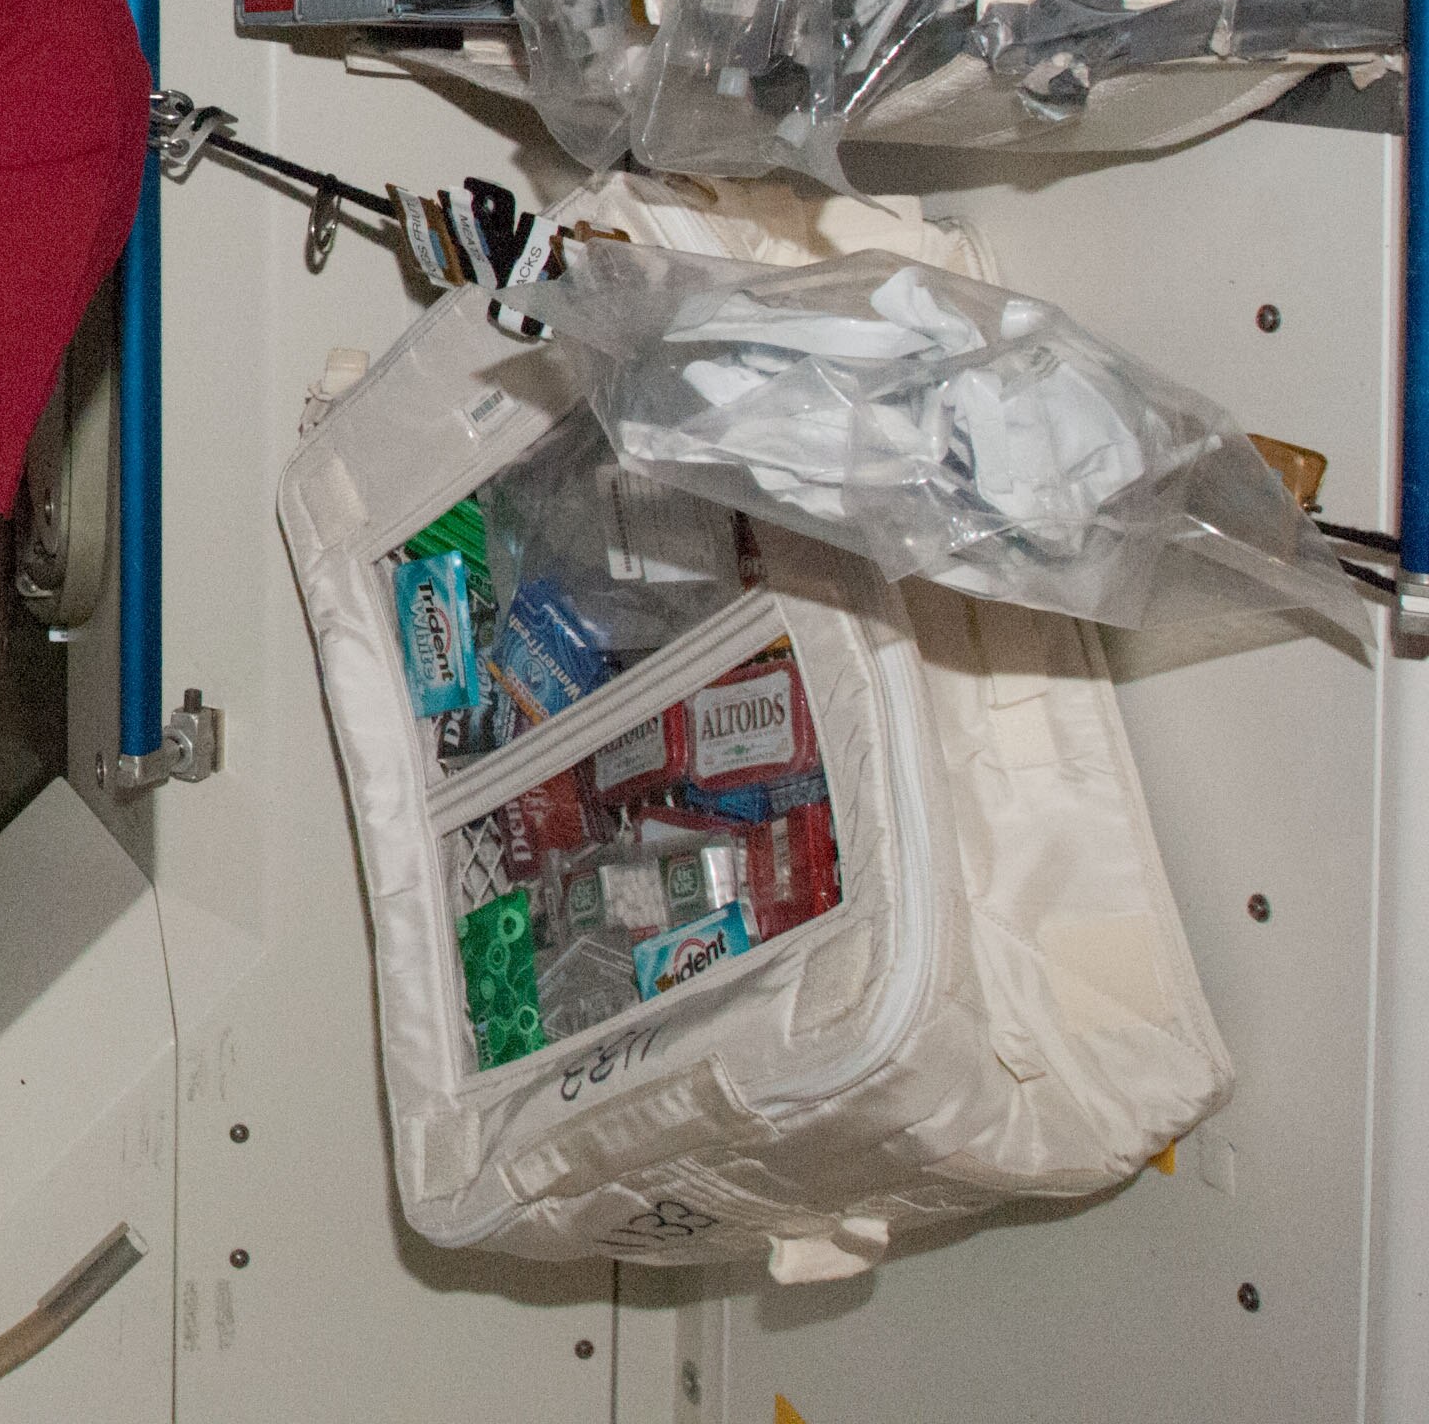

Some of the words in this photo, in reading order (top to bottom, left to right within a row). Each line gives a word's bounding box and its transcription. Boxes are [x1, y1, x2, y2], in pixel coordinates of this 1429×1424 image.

[418, 577, 455, 683] Trident
[509, 613, 582, 702] Winterfresh
[701, 692, 787, 742] ALTOIDS
[674, 931, 727, 985] ident
